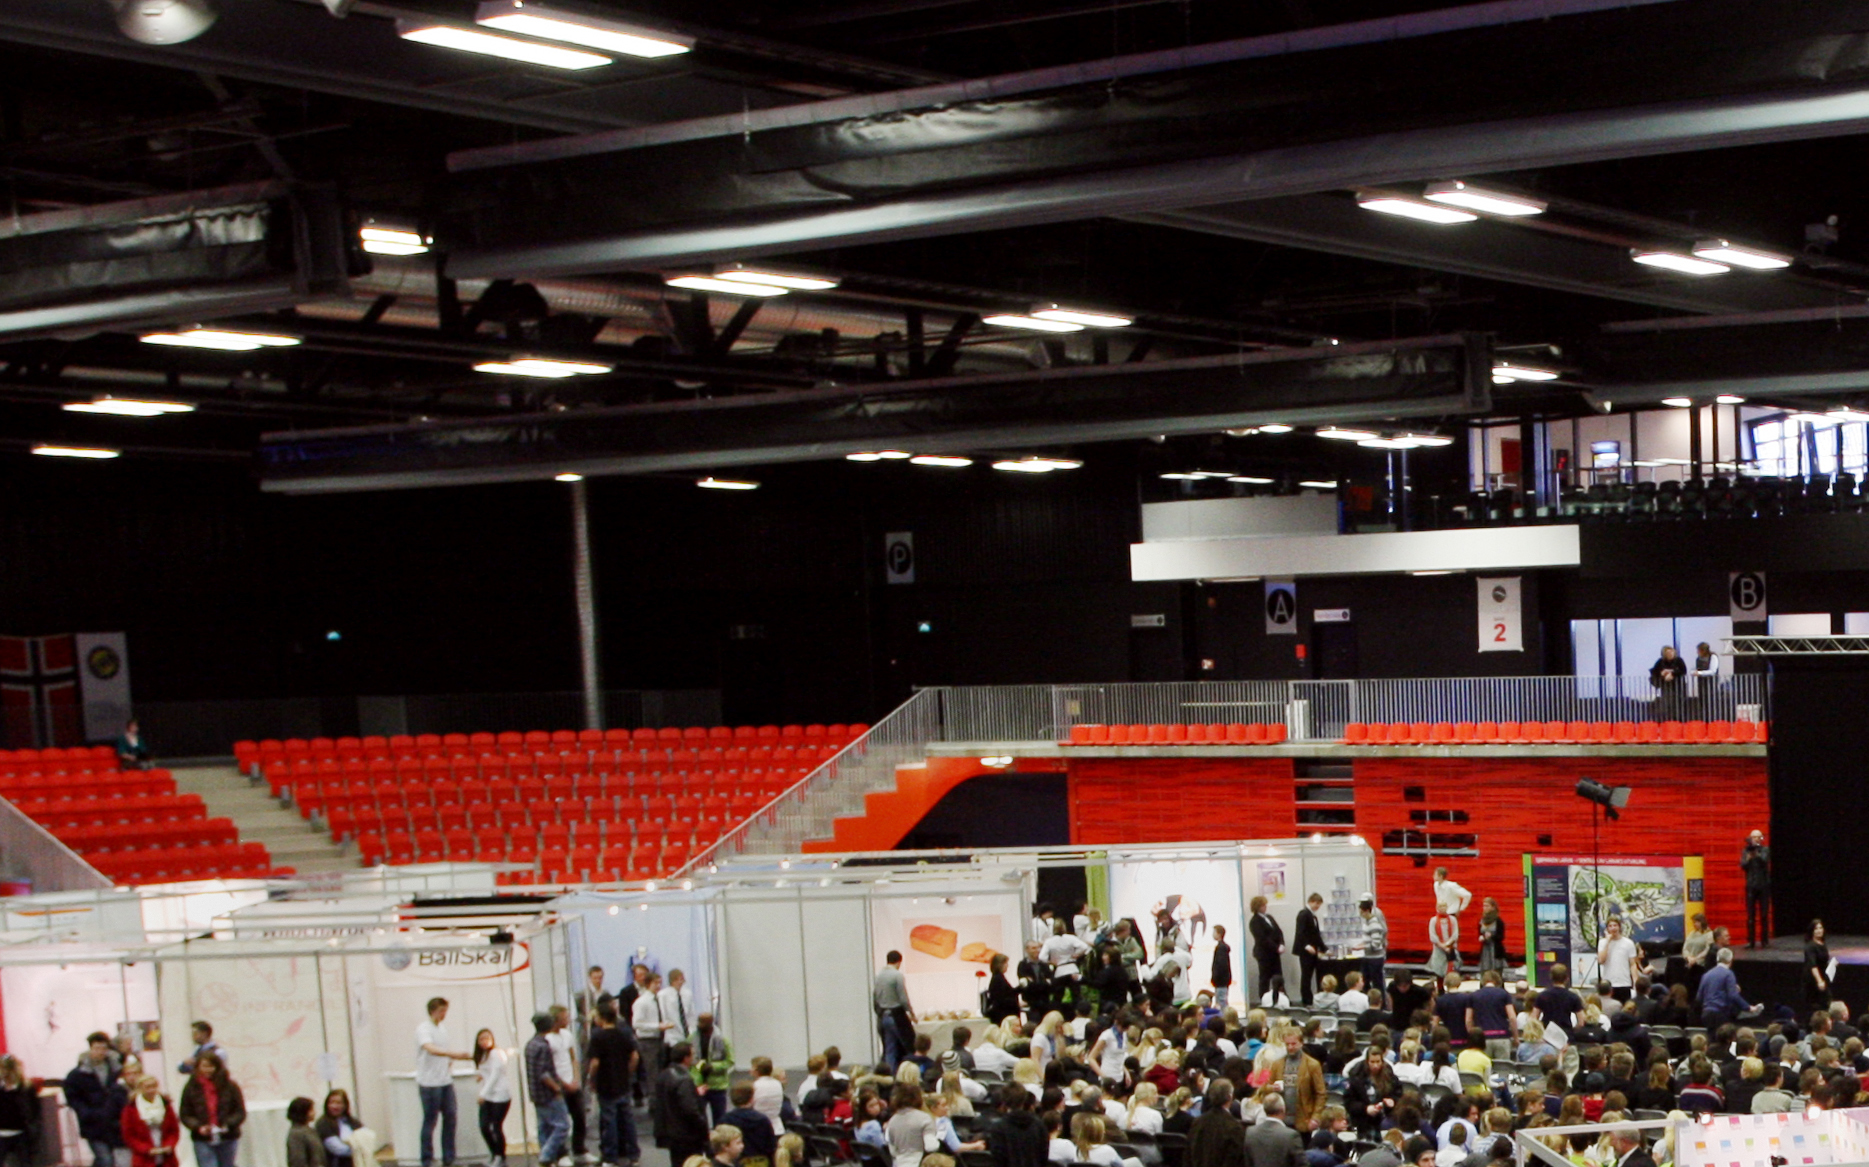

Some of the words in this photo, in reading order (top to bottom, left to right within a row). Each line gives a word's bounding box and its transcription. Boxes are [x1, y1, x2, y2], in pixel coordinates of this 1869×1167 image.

[894, 544, 907, 571] P
[1740, 577, 1757, 608] B
[1273, 593, 1290, 624] A
[1494, 623, 1507, 642] 2
